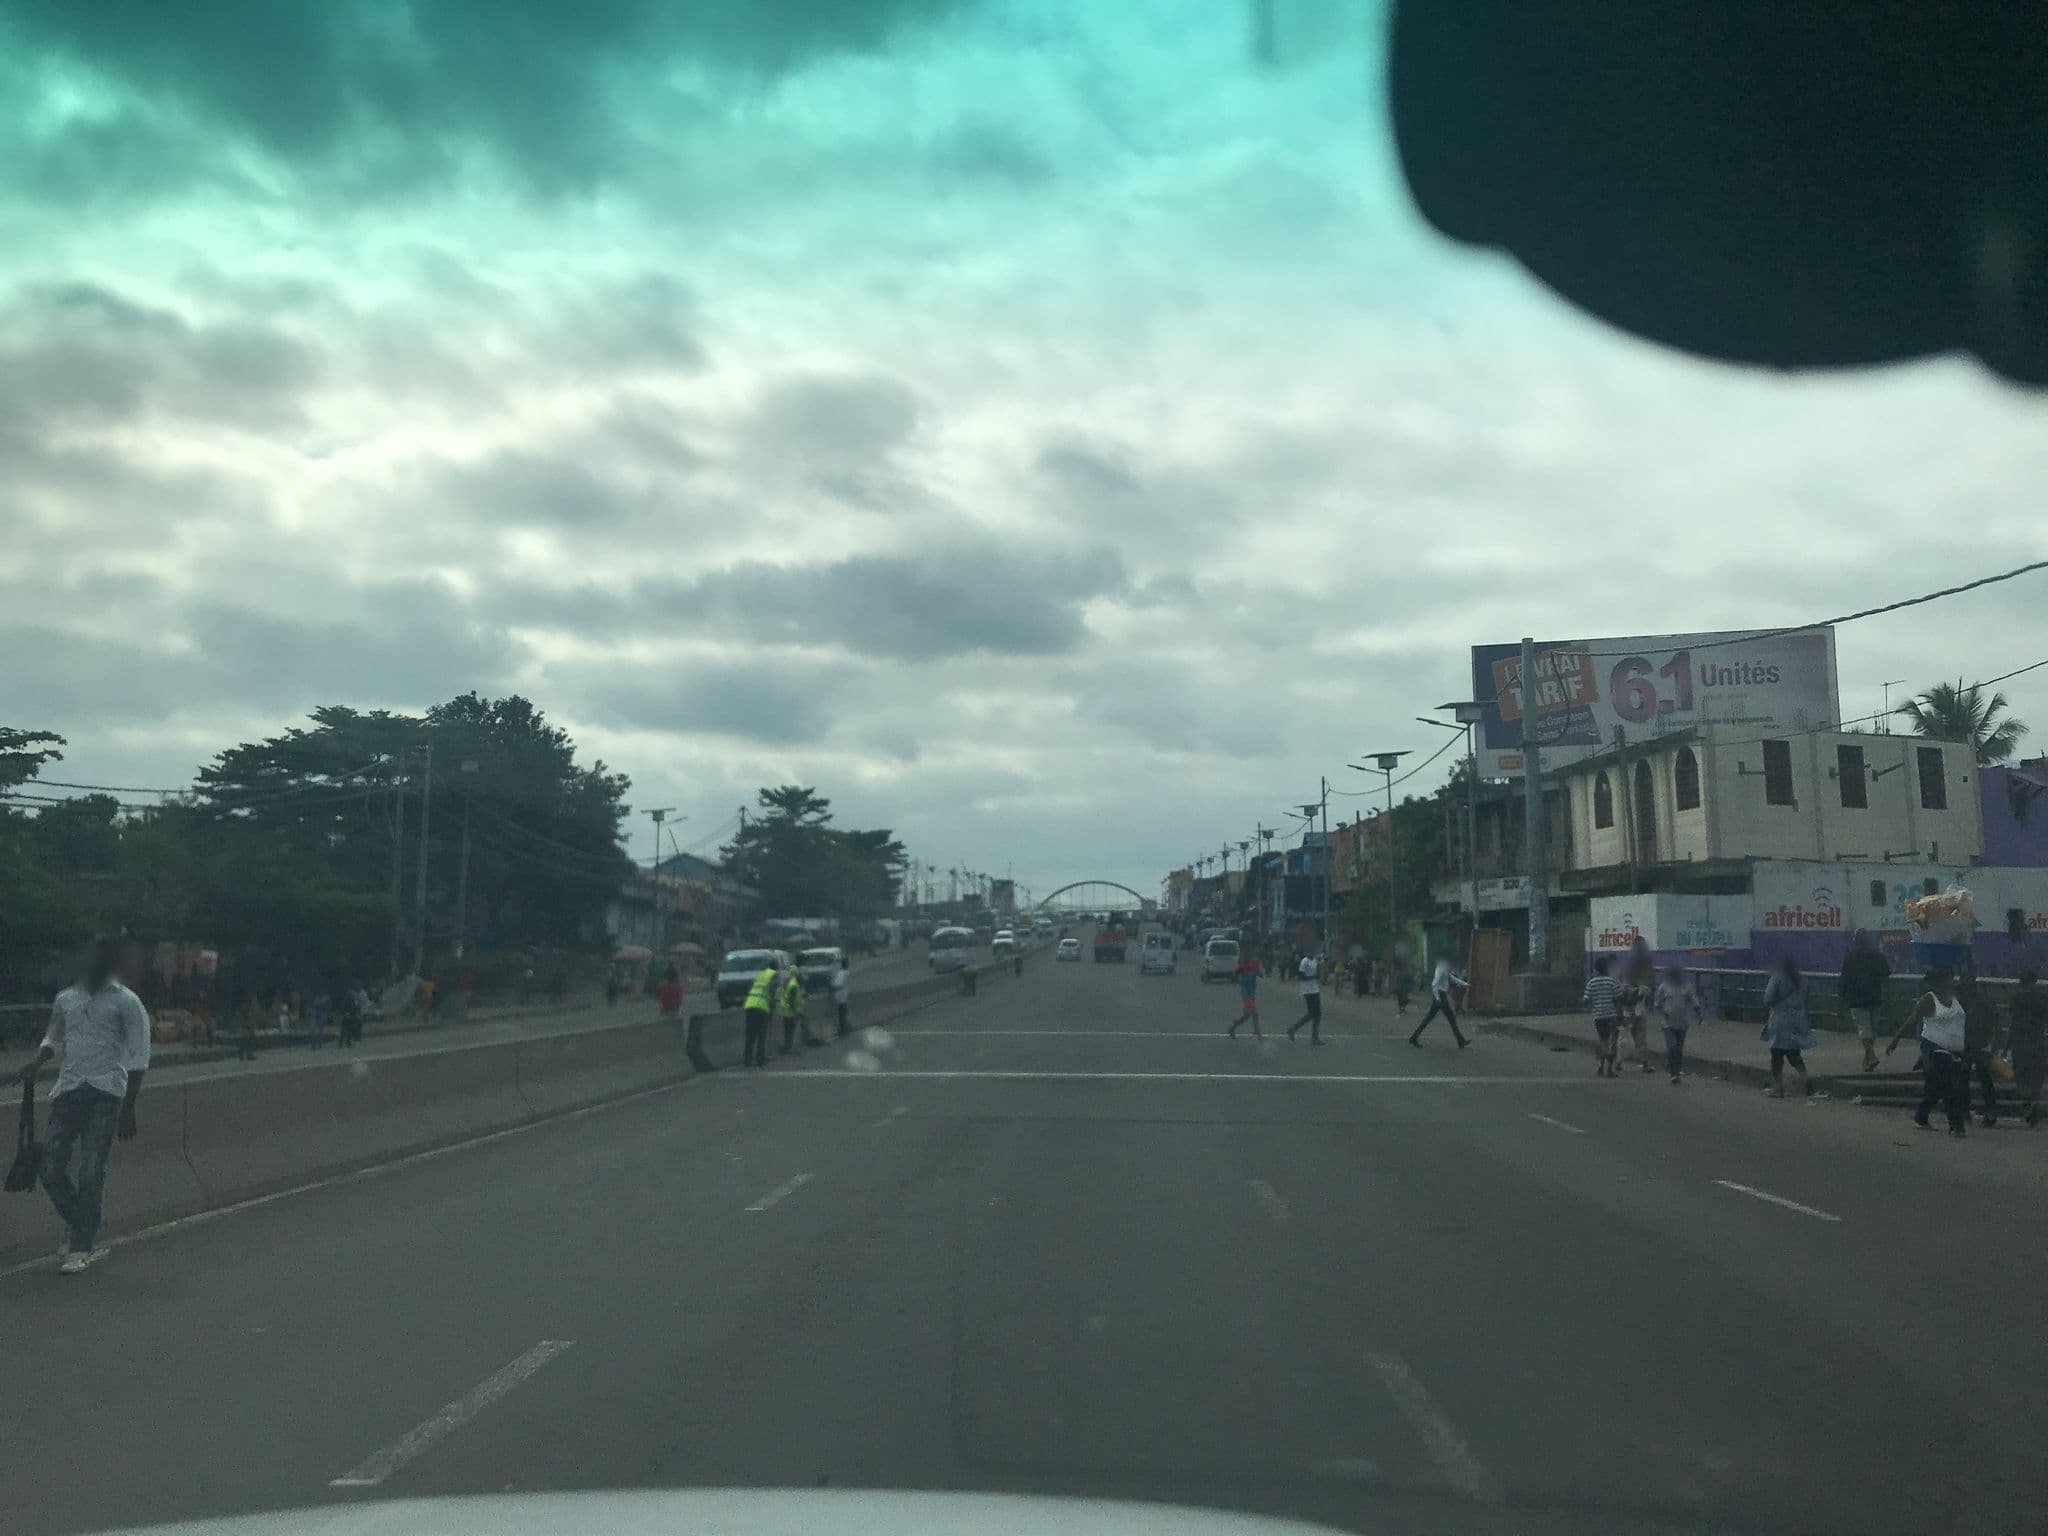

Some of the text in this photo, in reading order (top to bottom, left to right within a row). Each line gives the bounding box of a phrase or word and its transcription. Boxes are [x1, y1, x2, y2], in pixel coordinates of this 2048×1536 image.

[1700, 660, 1781, 687] Unités
[1764, 905, 1841, 927] africell
[1598, 926, 1641, 948] africell
